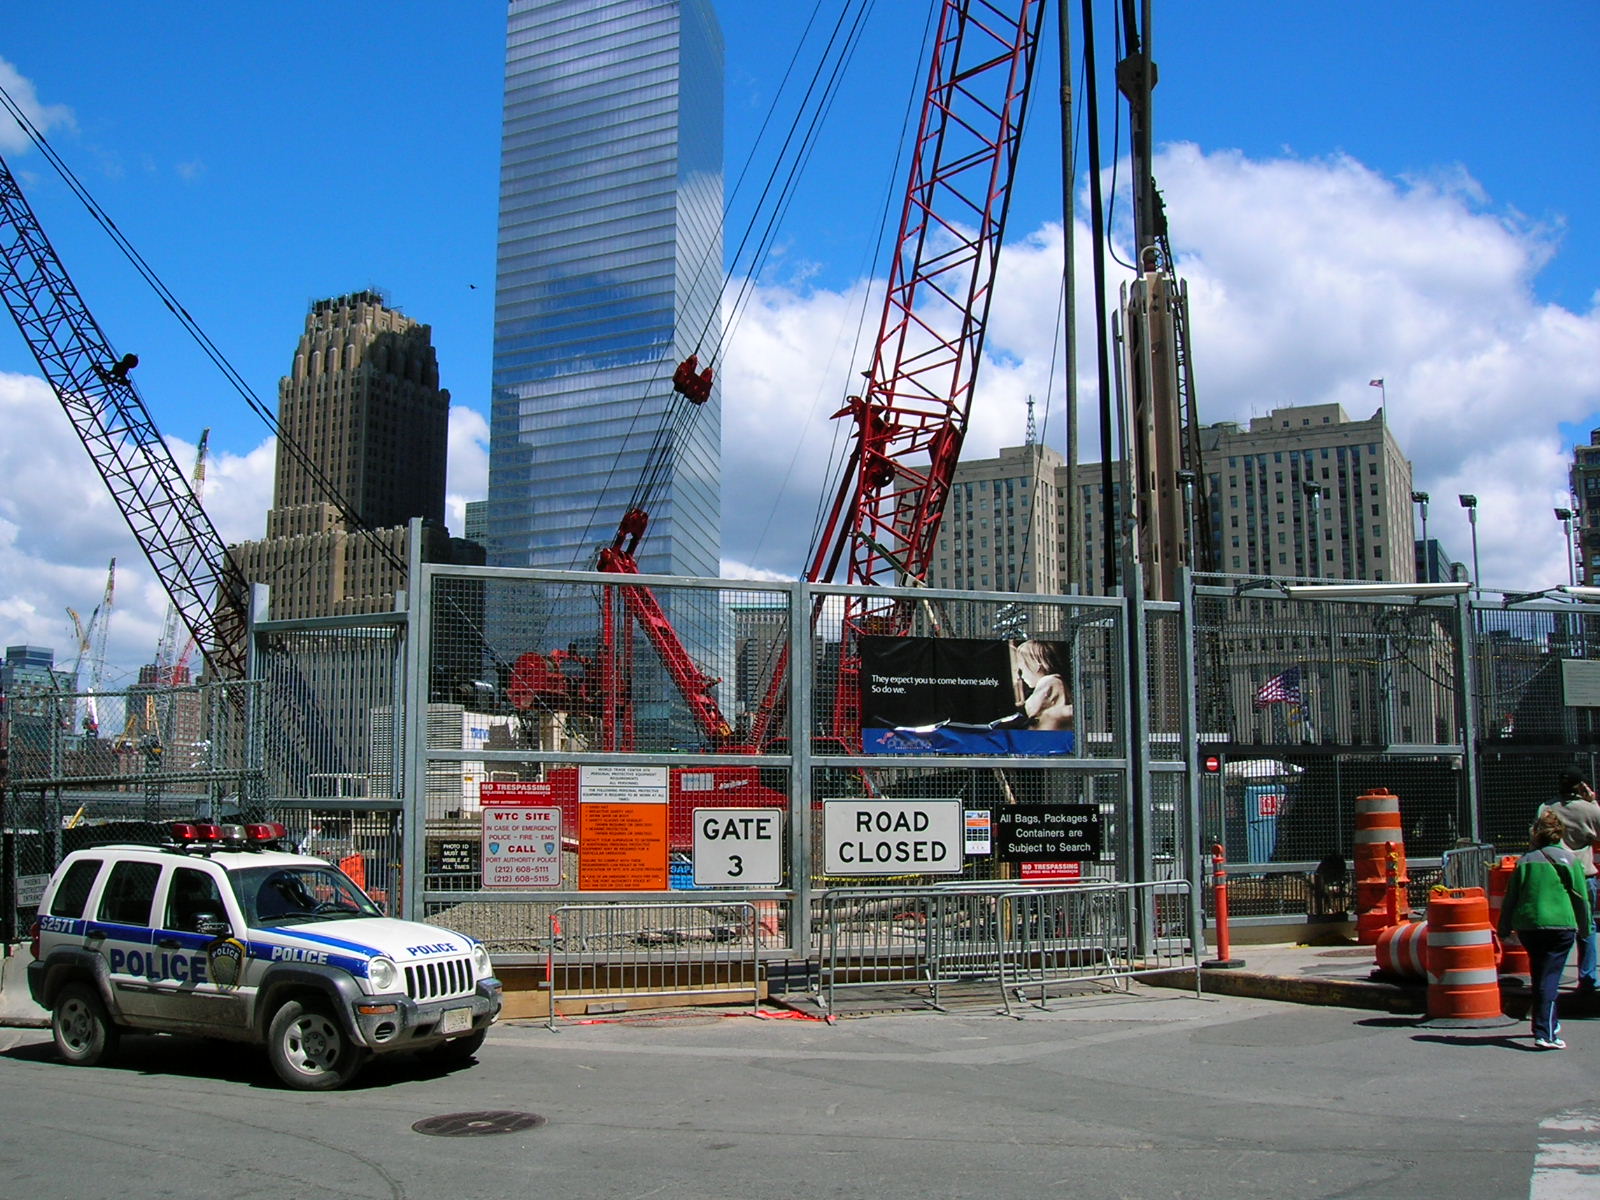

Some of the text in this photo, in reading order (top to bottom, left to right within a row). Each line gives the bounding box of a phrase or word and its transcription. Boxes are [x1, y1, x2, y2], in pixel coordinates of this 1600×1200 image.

[872, 674, 889, 684] They
[890, 676, 914, 684] expect
[957, 677, 978, 686] home
[978, 678, 1000, 688] safely.
[872, 685, 882, 693] So
[882, 685, 892, 694] do
[856, 811, 929, 832] ROAD
[1000, 814, 1011, 822] All
[1015, 814, 1040, 824] Bags,
[1044, 814, 1087, 824] Packages
[1092, 814, 1098, 822] &
[703, 818, 771, 840] GATE
[1016, 828, 1065, 838] Containers
[839, 842, 946, 863] CLOSED
[1008, 843, 1042, 853] Subject
[1059, 843, 1091, 852] Search
[727, 855, 743, 877] 3
[41, 918, 74, 933] S2571
[211, 948, 240, 960] POLICE
[271, 946, 328, 965] POLICE
[406, 943, 458, 956] POLICE
[110, 948, 208, 983] POLICE
